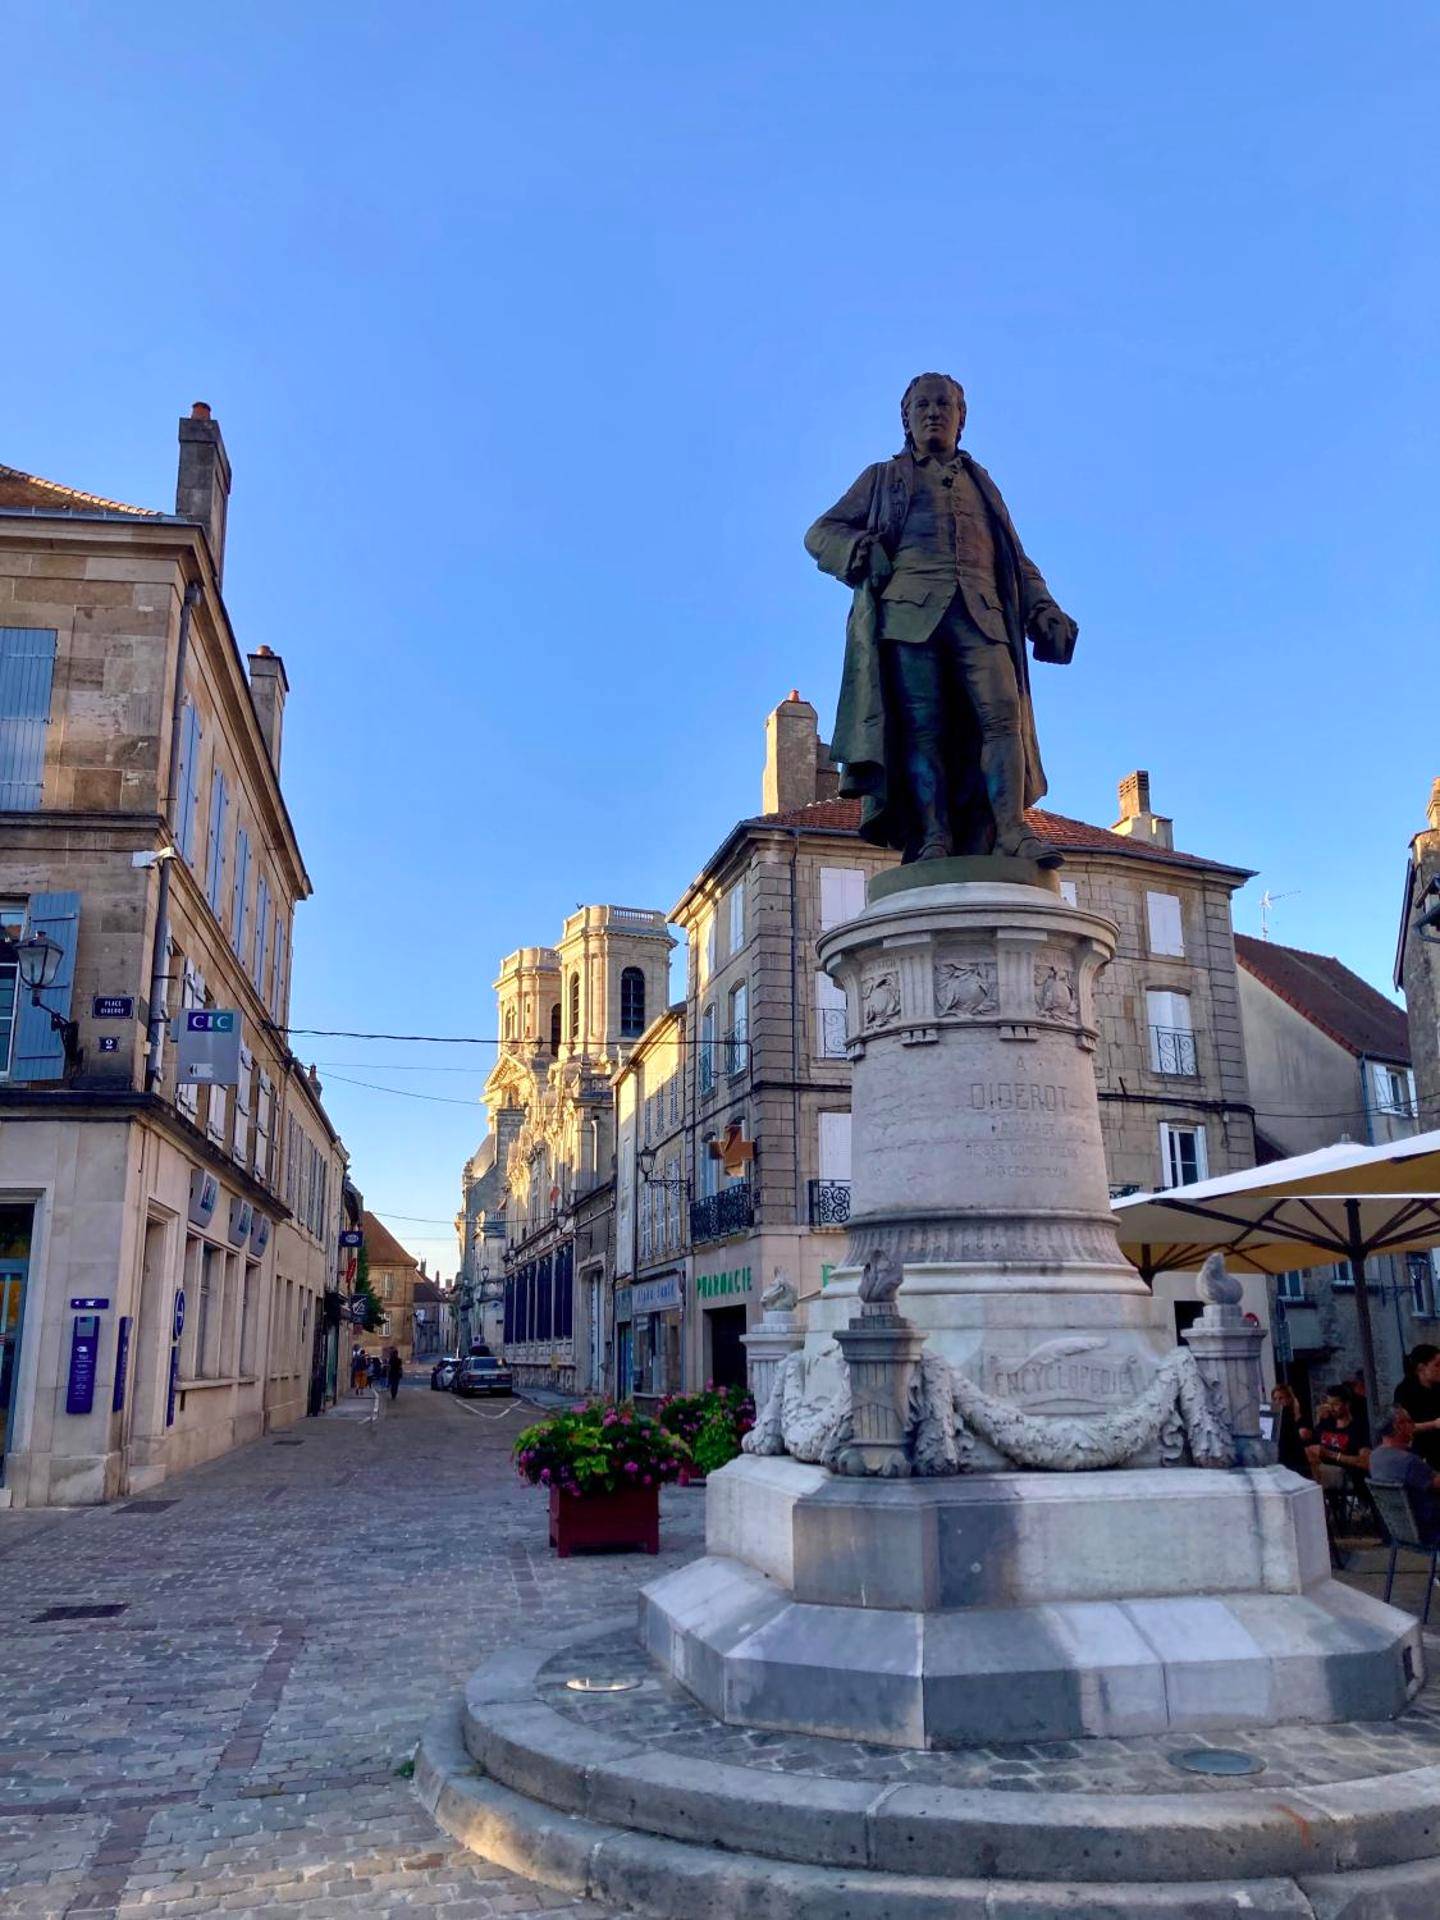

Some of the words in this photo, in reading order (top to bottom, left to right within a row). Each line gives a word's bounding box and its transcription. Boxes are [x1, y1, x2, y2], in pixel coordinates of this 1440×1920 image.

[192, 1015, 229, 1029] CIC
[970, 1083, 1067, 1111] DIDEROT
[696, 1266, 752, 1299] PHARMACIE
